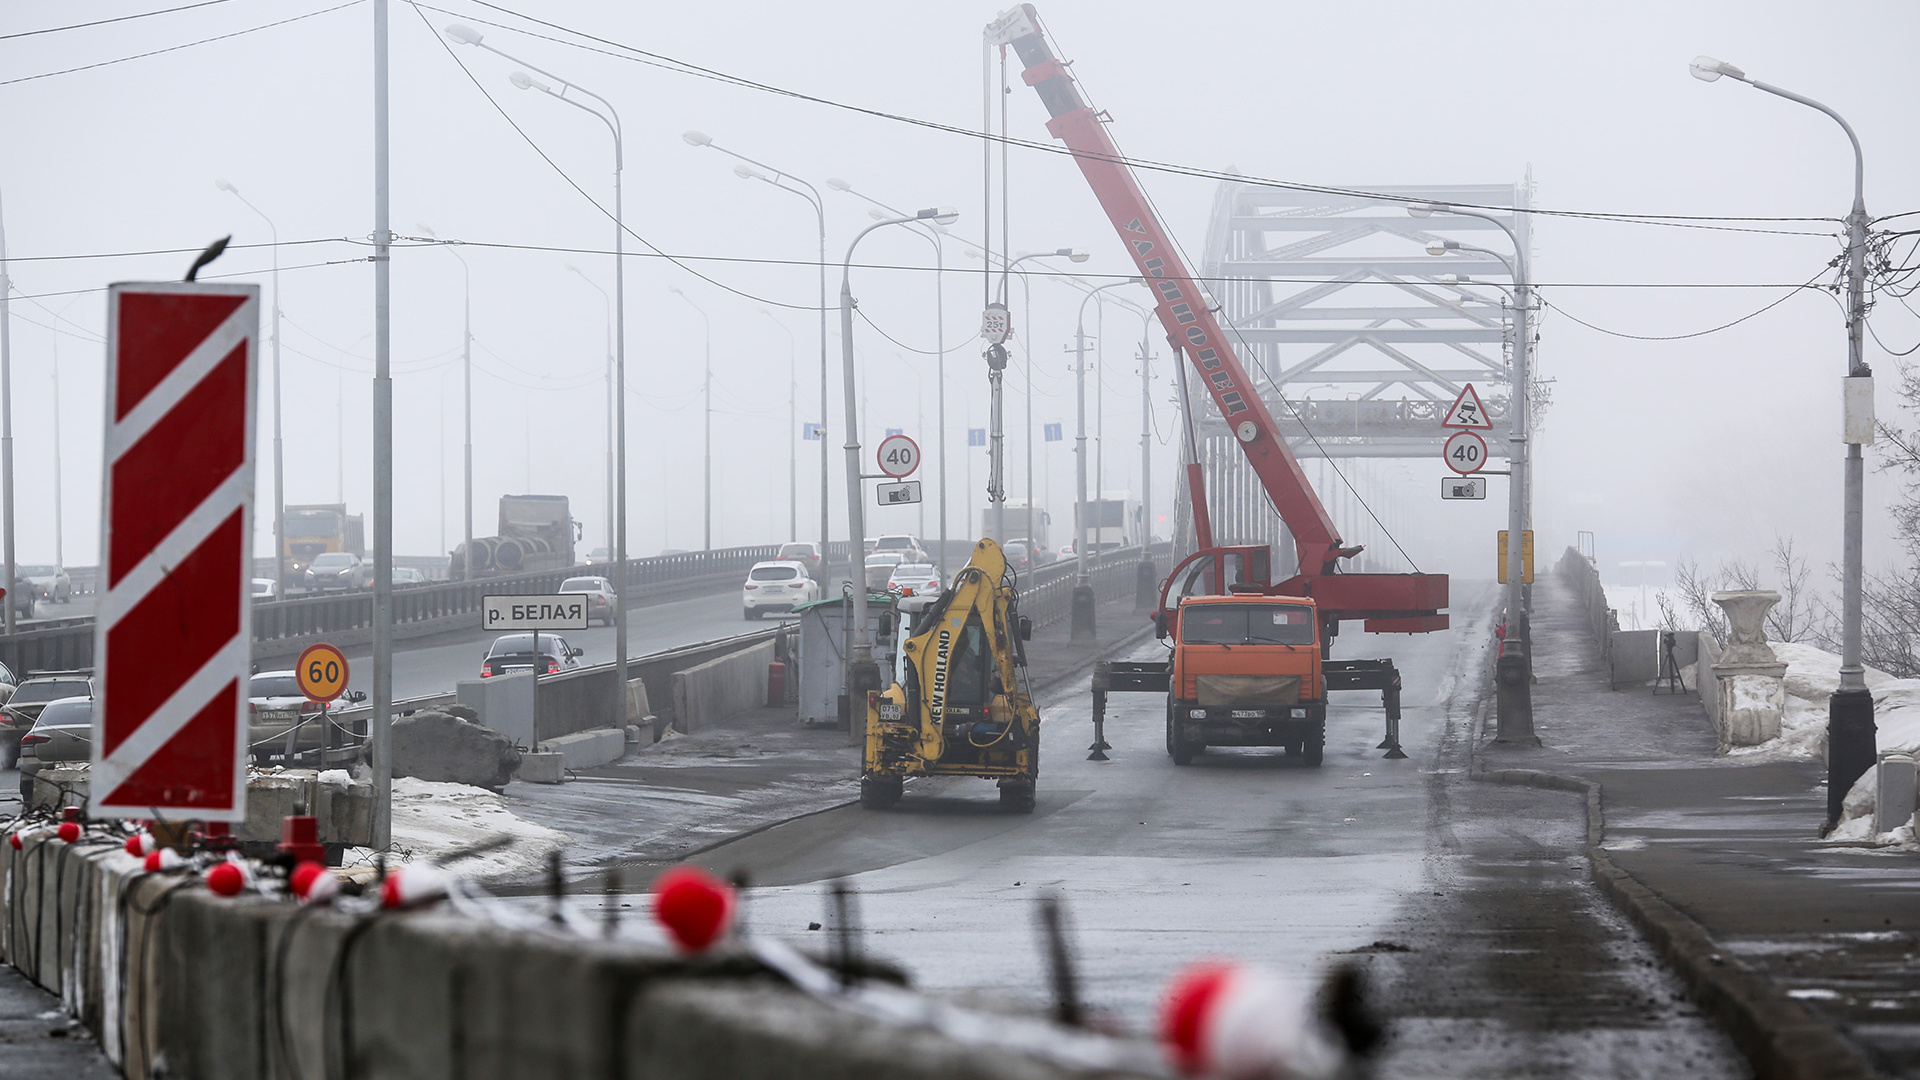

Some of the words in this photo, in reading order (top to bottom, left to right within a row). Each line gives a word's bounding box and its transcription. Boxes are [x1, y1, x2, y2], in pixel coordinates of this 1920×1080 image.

[1123, 217, 1248, 416] УЛЬЯНОВЕЦ
[886, 448, 911, 465] 40
[1452, 445, 1478, 462] 40
[488, 608, 505, 624] р.
[512, 604, 582, 620] БЕЛАЯ
[309, 660, 339, 683] 60
[934, 630, 950, 693] HOLLAND
[930, 695, 944, 725] NEW
